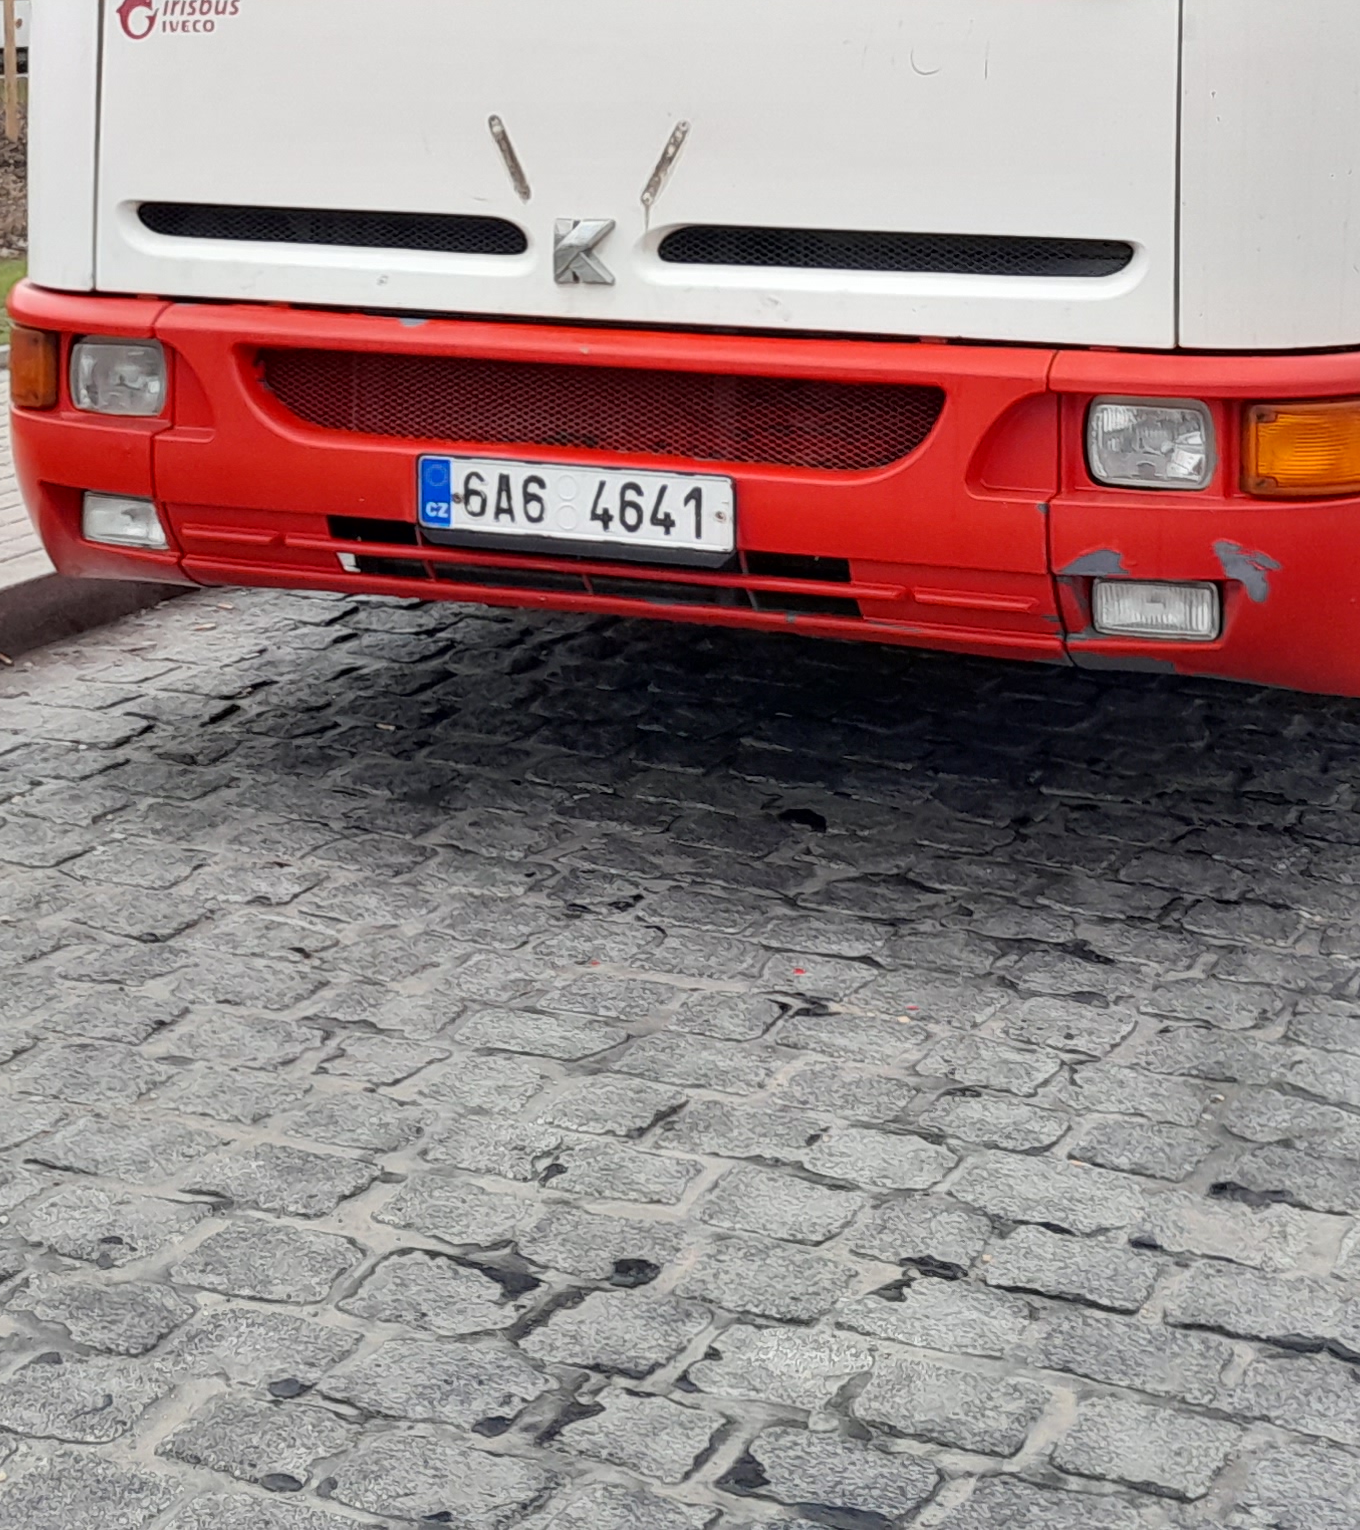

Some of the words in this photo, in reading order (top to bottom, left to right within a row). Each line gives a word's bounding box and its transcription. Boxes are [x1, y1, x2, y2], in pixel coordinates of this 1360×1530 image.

[161, 19, 215, 33] IVECO
[425, 502, 449, 518] CZ
[463, 471, 548, 523] 6A6
[590, 479, 703, 540] 4641
